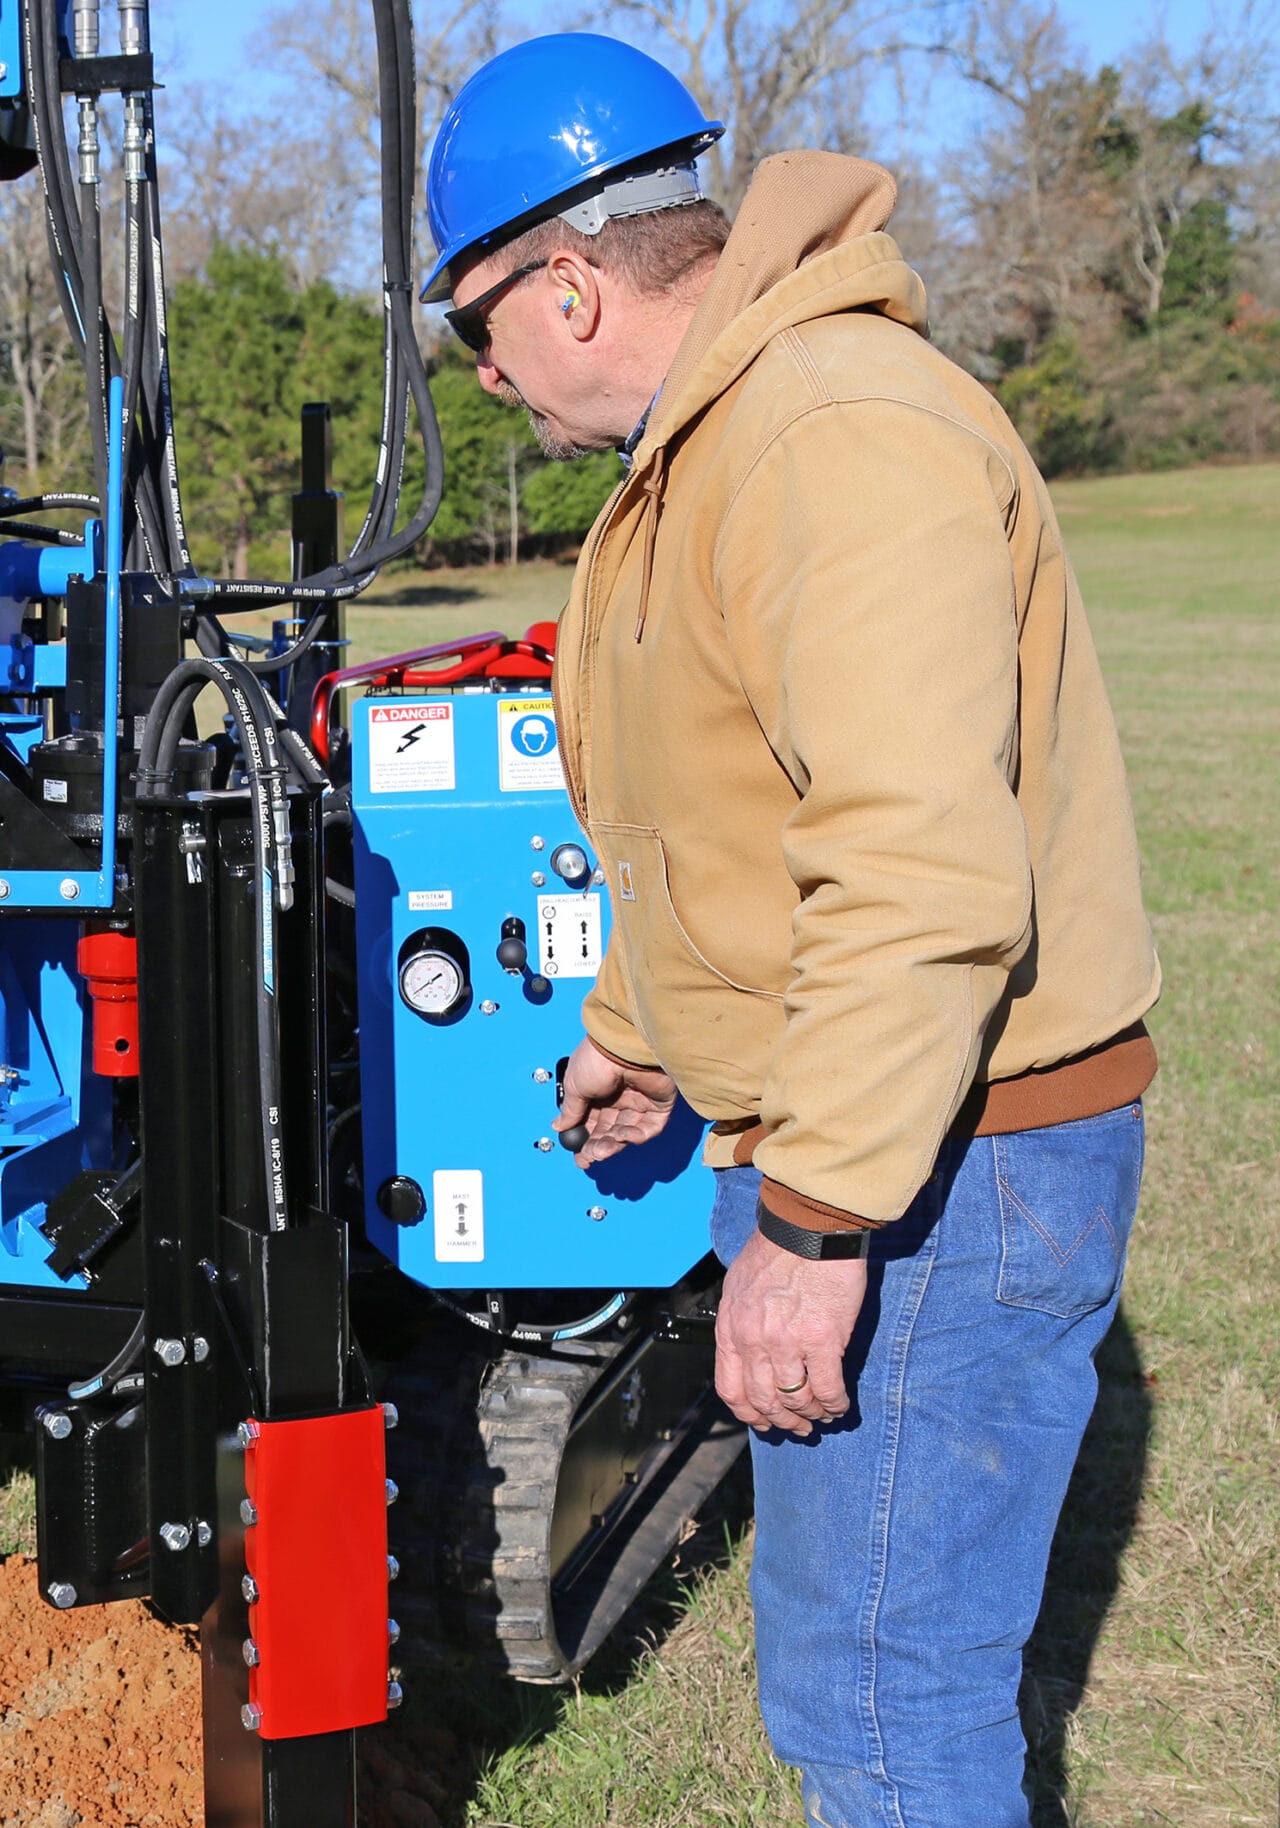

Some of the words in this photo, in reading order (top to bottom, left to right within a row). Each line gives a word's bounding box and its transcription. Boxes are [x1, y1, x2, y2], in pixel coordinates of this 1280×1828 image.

[166, 435, 177, 482] RESISTANT
[170, 488, 181, 513] MSHA
[180, 549, 190, 564] CSI
[226, 584, 262, 593] RESISTANT
[263, 585, 285, 595] FLAME
[389, 706, 447, 721] DANGER
[523, 702, 554, 711] CAUTIO
[263, 727, 276, 745] CSI
[244, 727, 264, 769] EXCEEDS
[257, 784, 268, 804] WP
[259, 805, 270, 821] PSI
[263, 824, 271, 848] 5000
[269, 1106, 279, 1125] CSI
[271, 1138, 282, 1171] IC-8/19
[273, 1173, 285, 1204] MSHA
